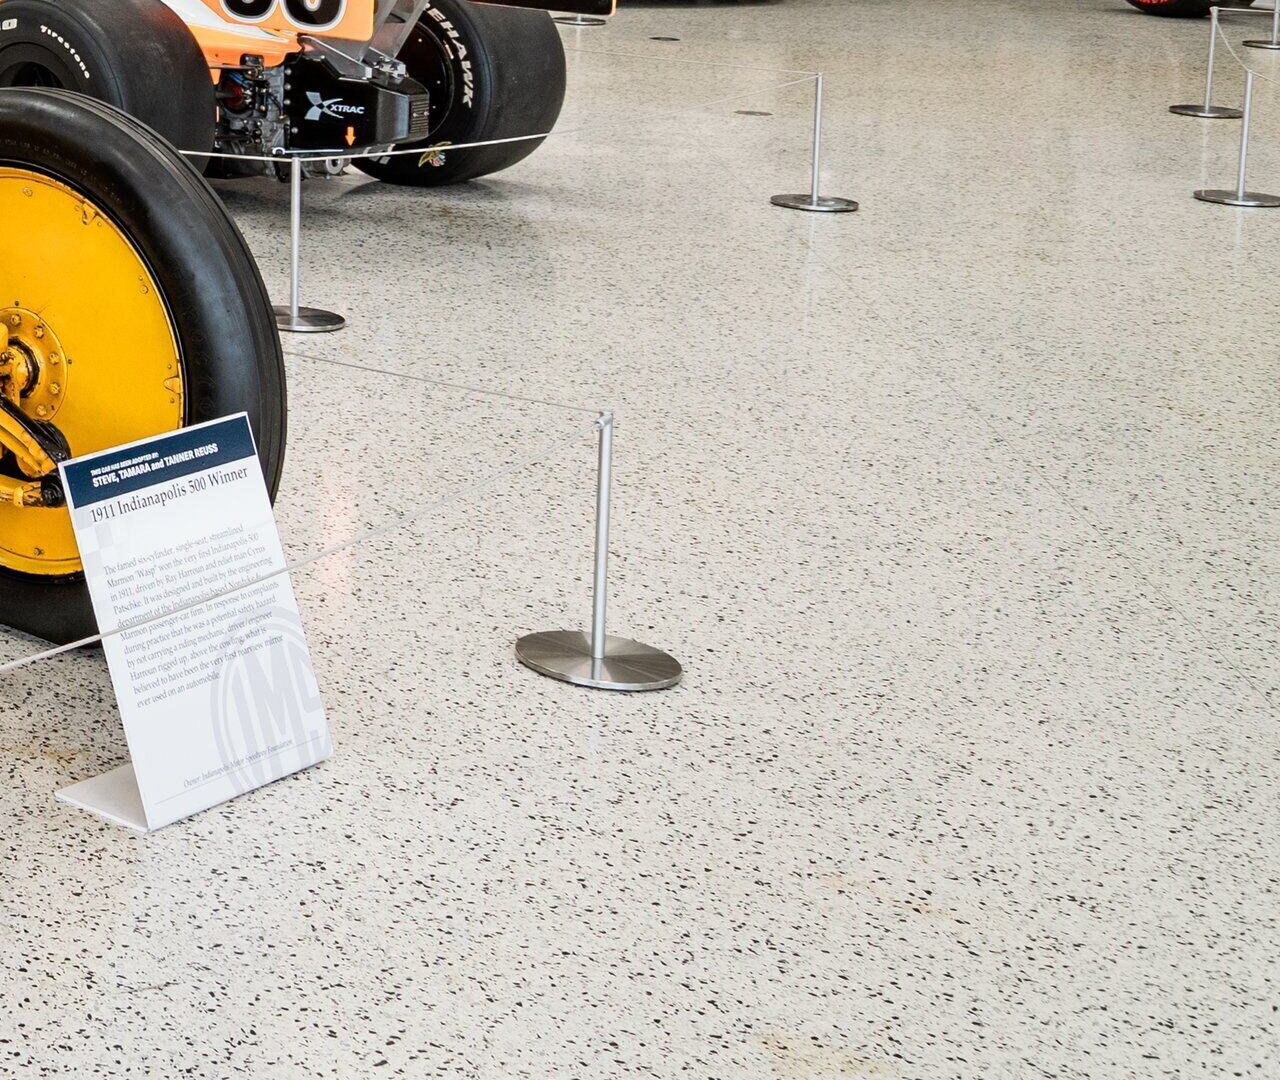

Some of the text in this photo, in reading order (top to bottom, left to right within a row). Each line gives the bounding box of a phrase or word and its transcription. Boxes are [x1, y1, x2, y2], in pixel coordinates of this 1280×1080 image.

[40, 24, 91, 79] Firestone
[329, 104, 364, 115] XTRAC
[92, 442, 219, 488] STEVE, TAMARA and TANNER REUSS
[91, 468, 248, 522] 1911 Indianapolis 500 Winner
